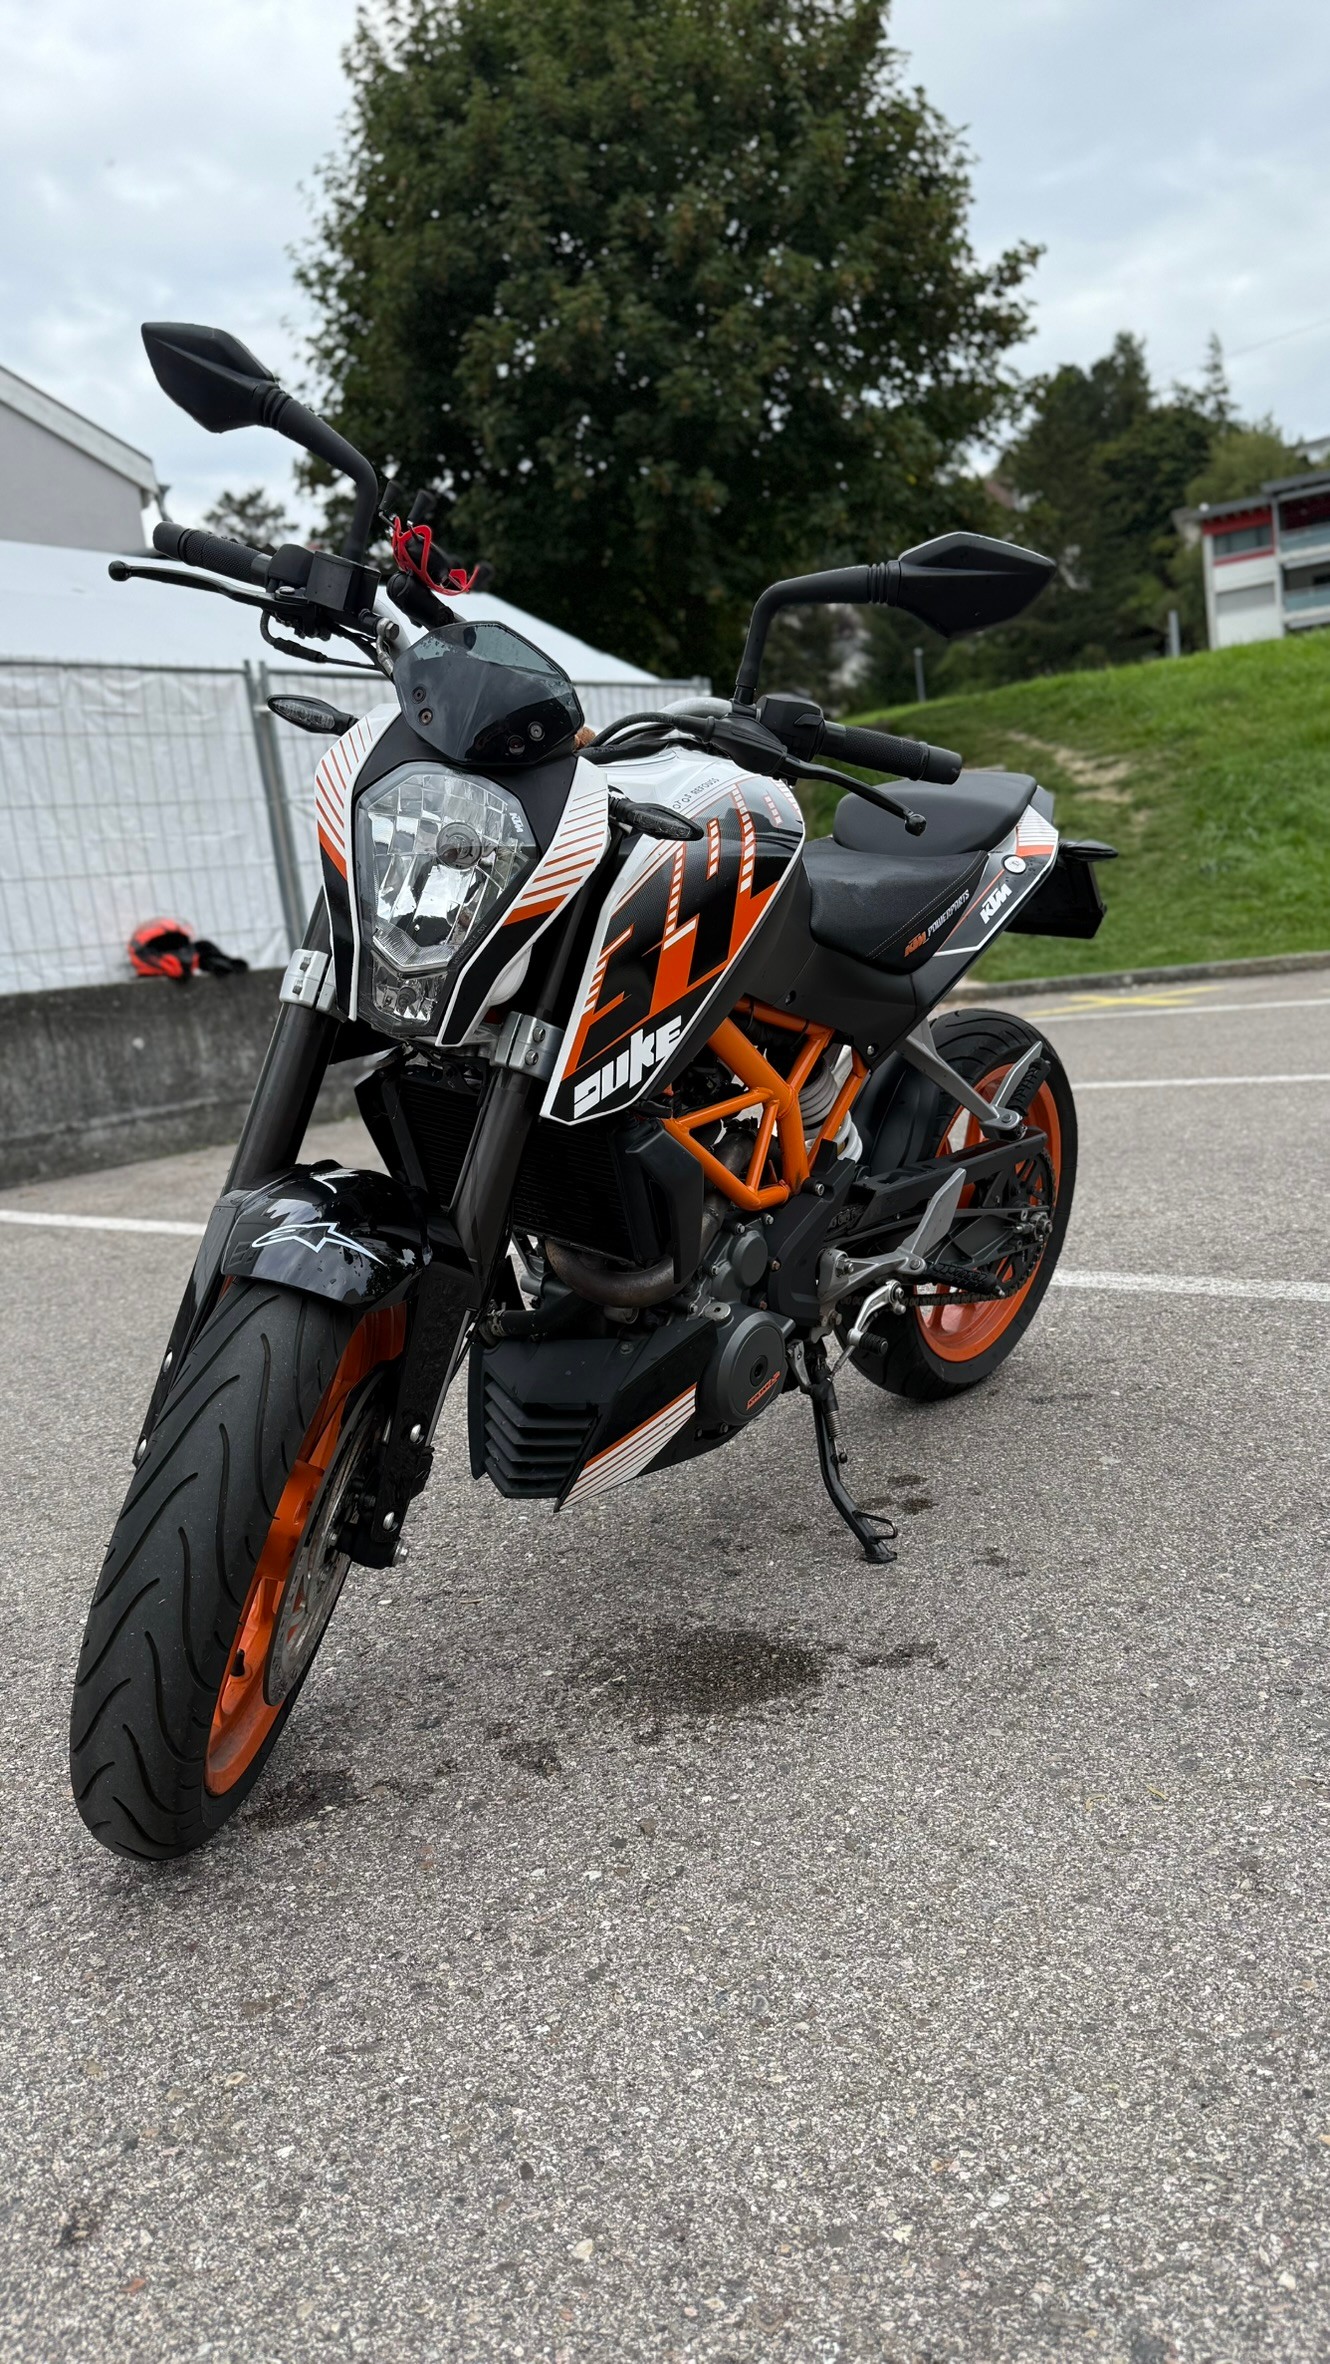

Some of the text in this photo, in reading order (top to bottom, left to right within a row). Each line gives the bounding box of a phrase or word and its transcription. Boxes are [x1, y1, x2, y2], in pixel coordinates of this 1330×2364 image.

[509, 812, 524, 833] KTM
[927, 889, 970, 937] POWERPARTS
[979, 883, 1012, 925] KTM
[574, 1015, 682, 1119] DUKE
